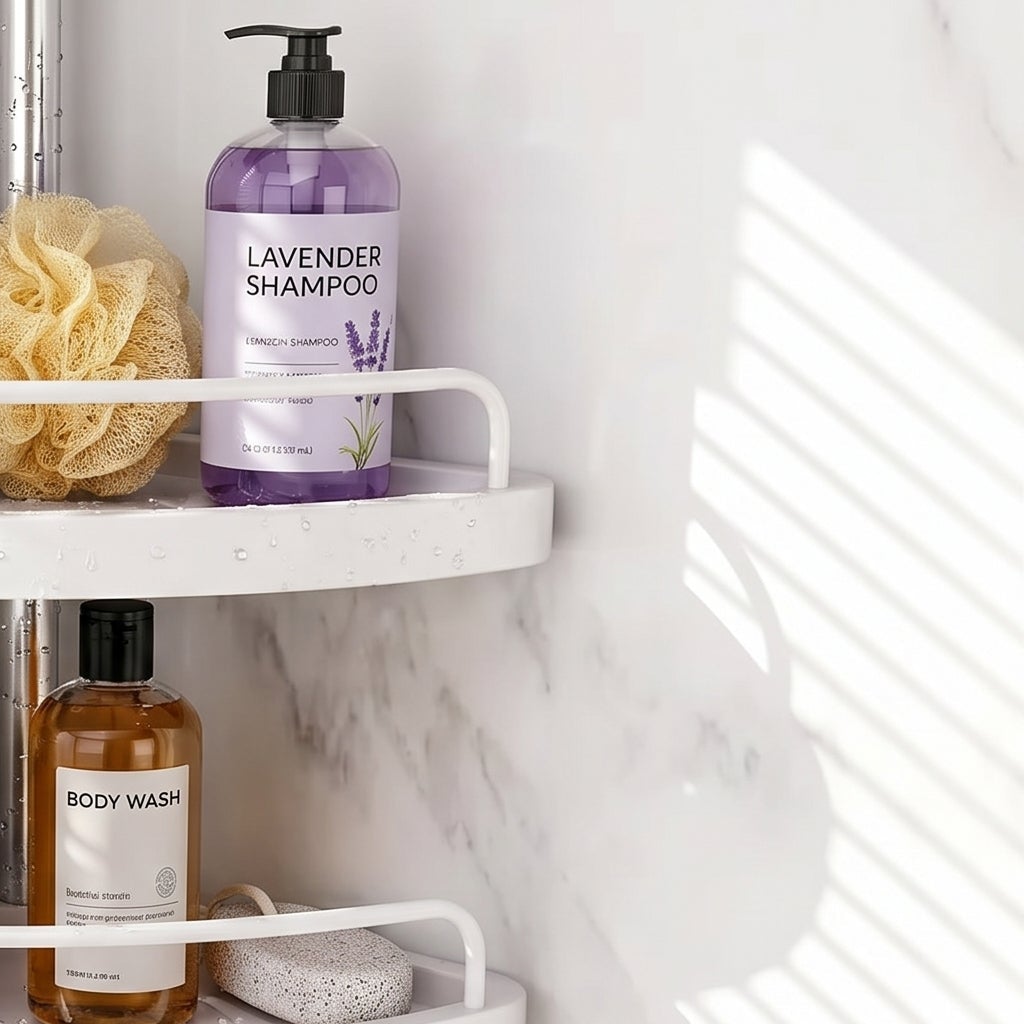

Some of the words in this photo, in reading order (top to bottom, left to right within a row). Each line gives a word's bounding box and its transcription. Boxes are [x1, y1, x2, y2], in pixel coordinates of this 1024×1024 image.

[248, 245, 381, 268] LAVENDER
[246, 273, 378, 297] SHAMPOO
[290, 337, 339, 346] SHAMPOO
[67, 790, 120, 809] BODY
[126, 789, 181, 809] WASH
